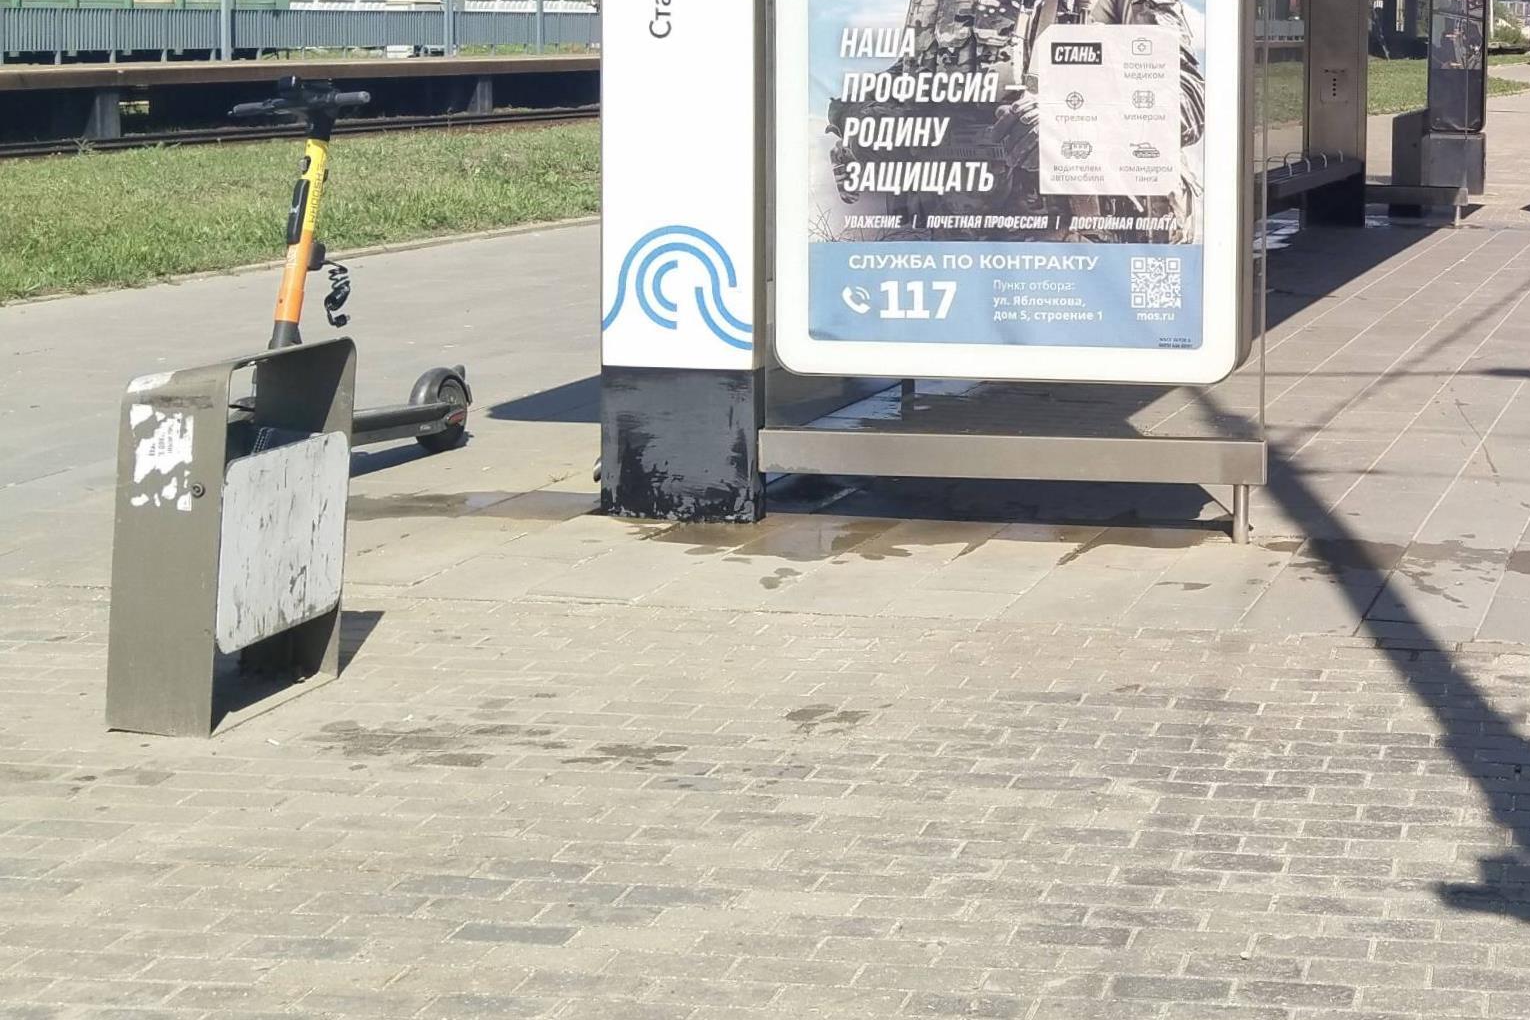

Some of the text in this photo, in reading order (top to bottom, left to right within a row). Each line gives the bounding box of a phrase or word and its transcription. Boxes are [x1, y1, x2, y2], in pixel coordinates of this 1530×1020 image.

[839, 27, 917, 59] НАША
[1054, 46, 1101, 63] СТАНЬ:
[1123, 71, 1166, 81] медиком
[841, 71, 1000, 103] ПРОФЕССИЯ
[842, 116, 951, 152] РОДИНУ
[1053, 164, 1103, 174] водителем
[1119, 164, 1174, 174] командиром
[843, 161, 996, 196] ЗАЩИЩАТЬ
[844, 214, 1178, 231] УВАЖЕНИЕ ПОЧЕТНАЯ ПРОФЕССИЯ ДОСТОЙНАЯ ОПЛАТА
[848, 254, 1099, 272] СЛУЖБА ПО КОНТРАКТУ
[993, 279, 1077, 294] Пункт отбора:
[879, 280, 957, 320] 117
[993, 295, 1087, 309] ул. Яблочкова,
[993, 309, 1104, 323] дом 5, строение 1
[1136, 311, 1176, 322] mos.ru
